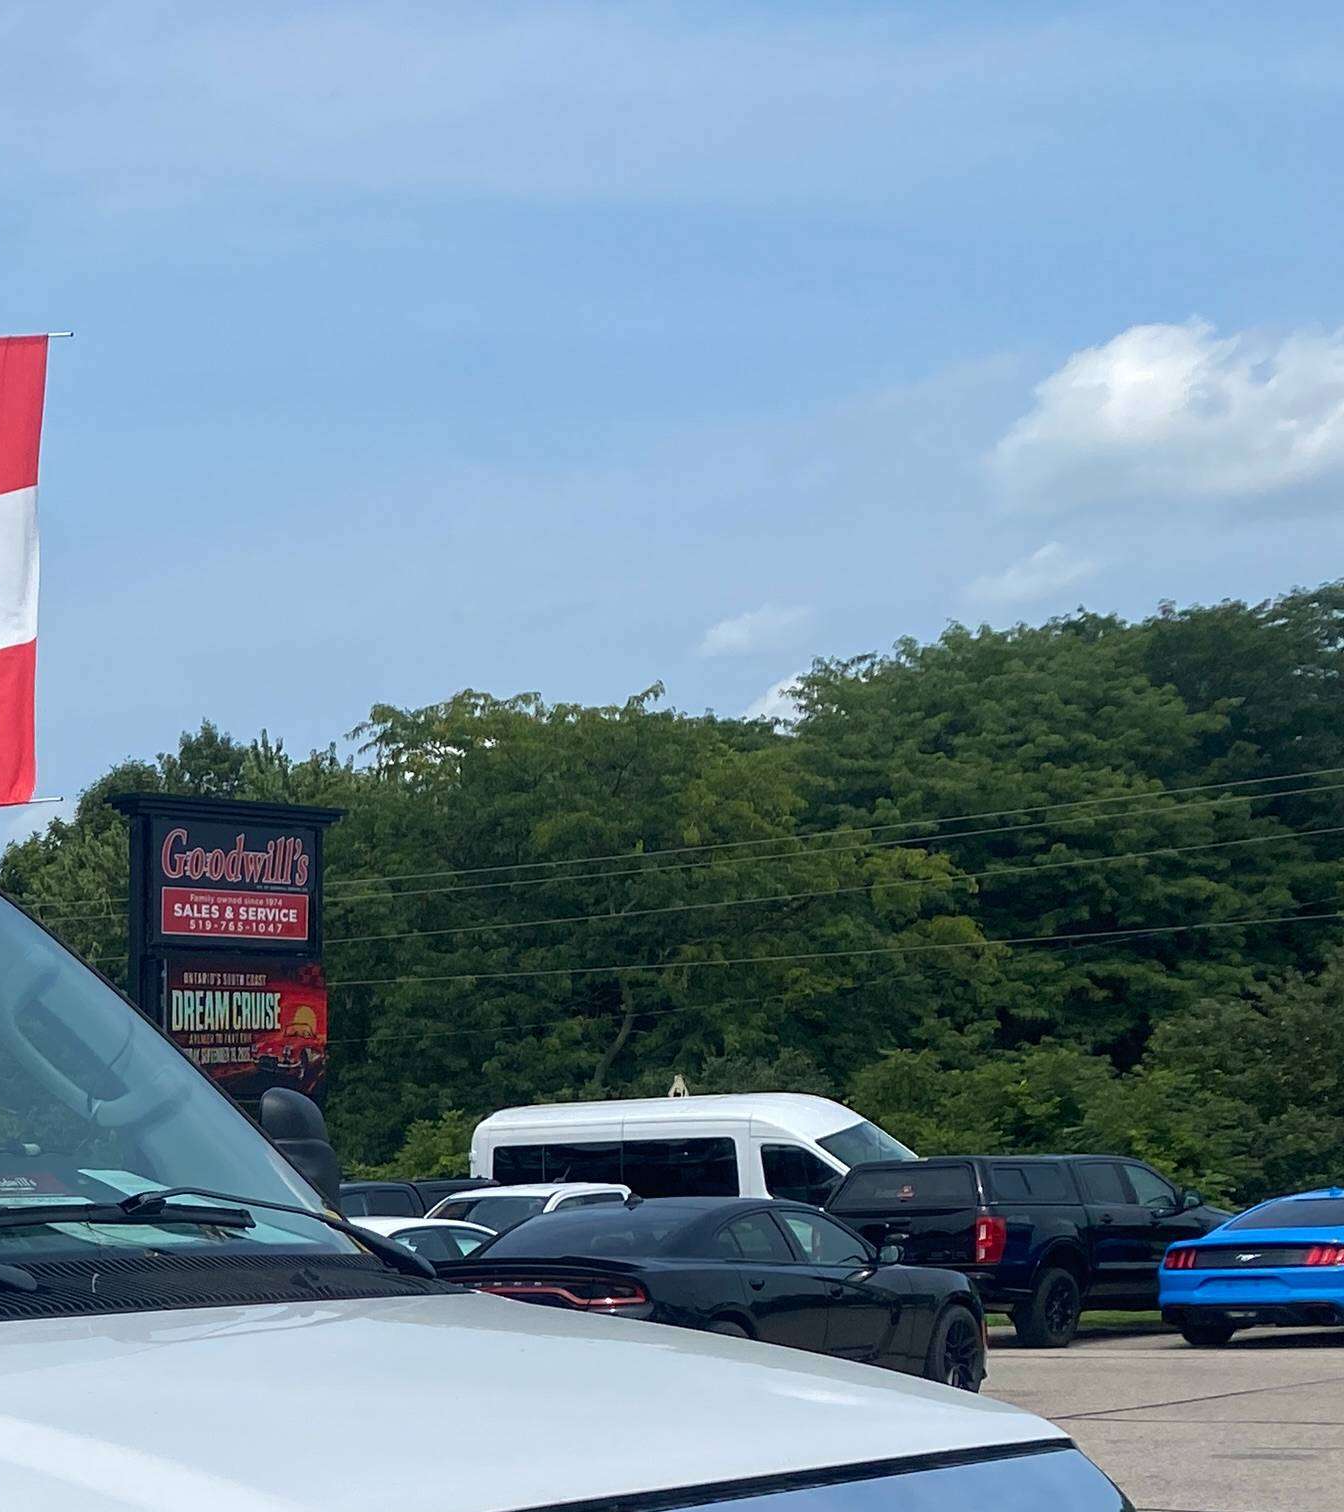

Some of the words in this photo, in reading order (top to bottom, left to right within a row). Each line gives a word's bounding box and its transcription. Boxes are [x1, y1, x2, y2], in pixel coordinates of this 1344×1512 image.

[162, 827, 309, 887] Goodwill's
[190, 894, 214, 905] Family
[217, 896, 242, 905] owned
[244, 897, 263, 906] since
[266, 898, 282, 907] 1974
[174, 903, 220, 918] SALES
[224, 906, 234, 919] &
[239, 907, 298, 922] SERVICE
[189, 919, 283, 933] 519-765-1047
[183, 972, 221, 986] ONTARIO'S
[223, 973, 244, 986] SOUTH
[171, 989, 230, 1032] DREAM
[232, 991, 282, 1031] CRUISE
